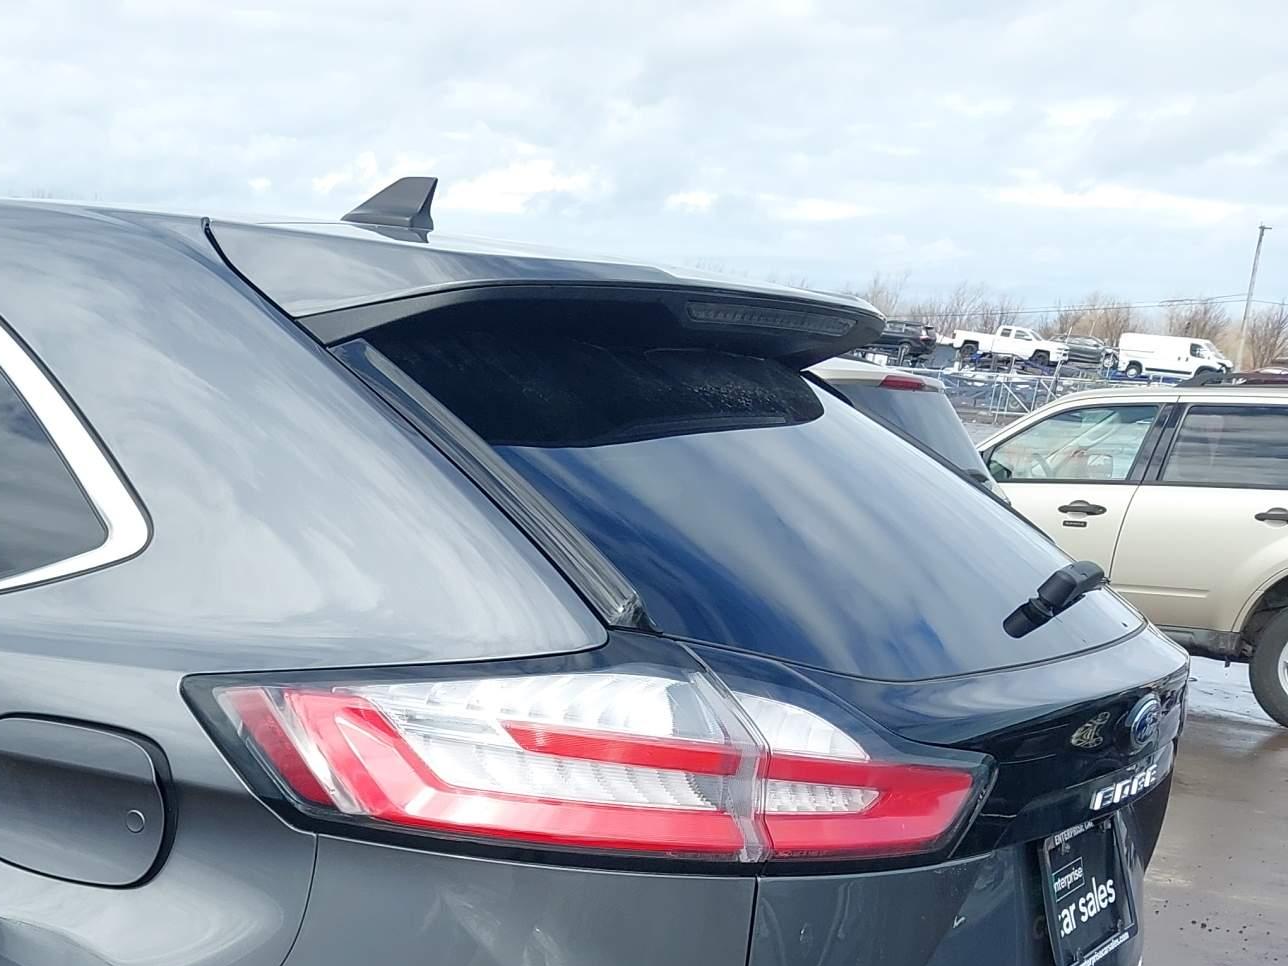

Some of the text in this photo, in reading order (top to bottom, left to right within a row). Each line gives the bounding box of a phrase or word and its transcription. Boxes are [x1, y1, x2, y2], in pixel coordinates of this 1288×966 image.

[1090, 763, 1158, 811] EDGE
[1053, 866, 1083, 893] nterprise
[1079, 877, 1116, 923] sales
